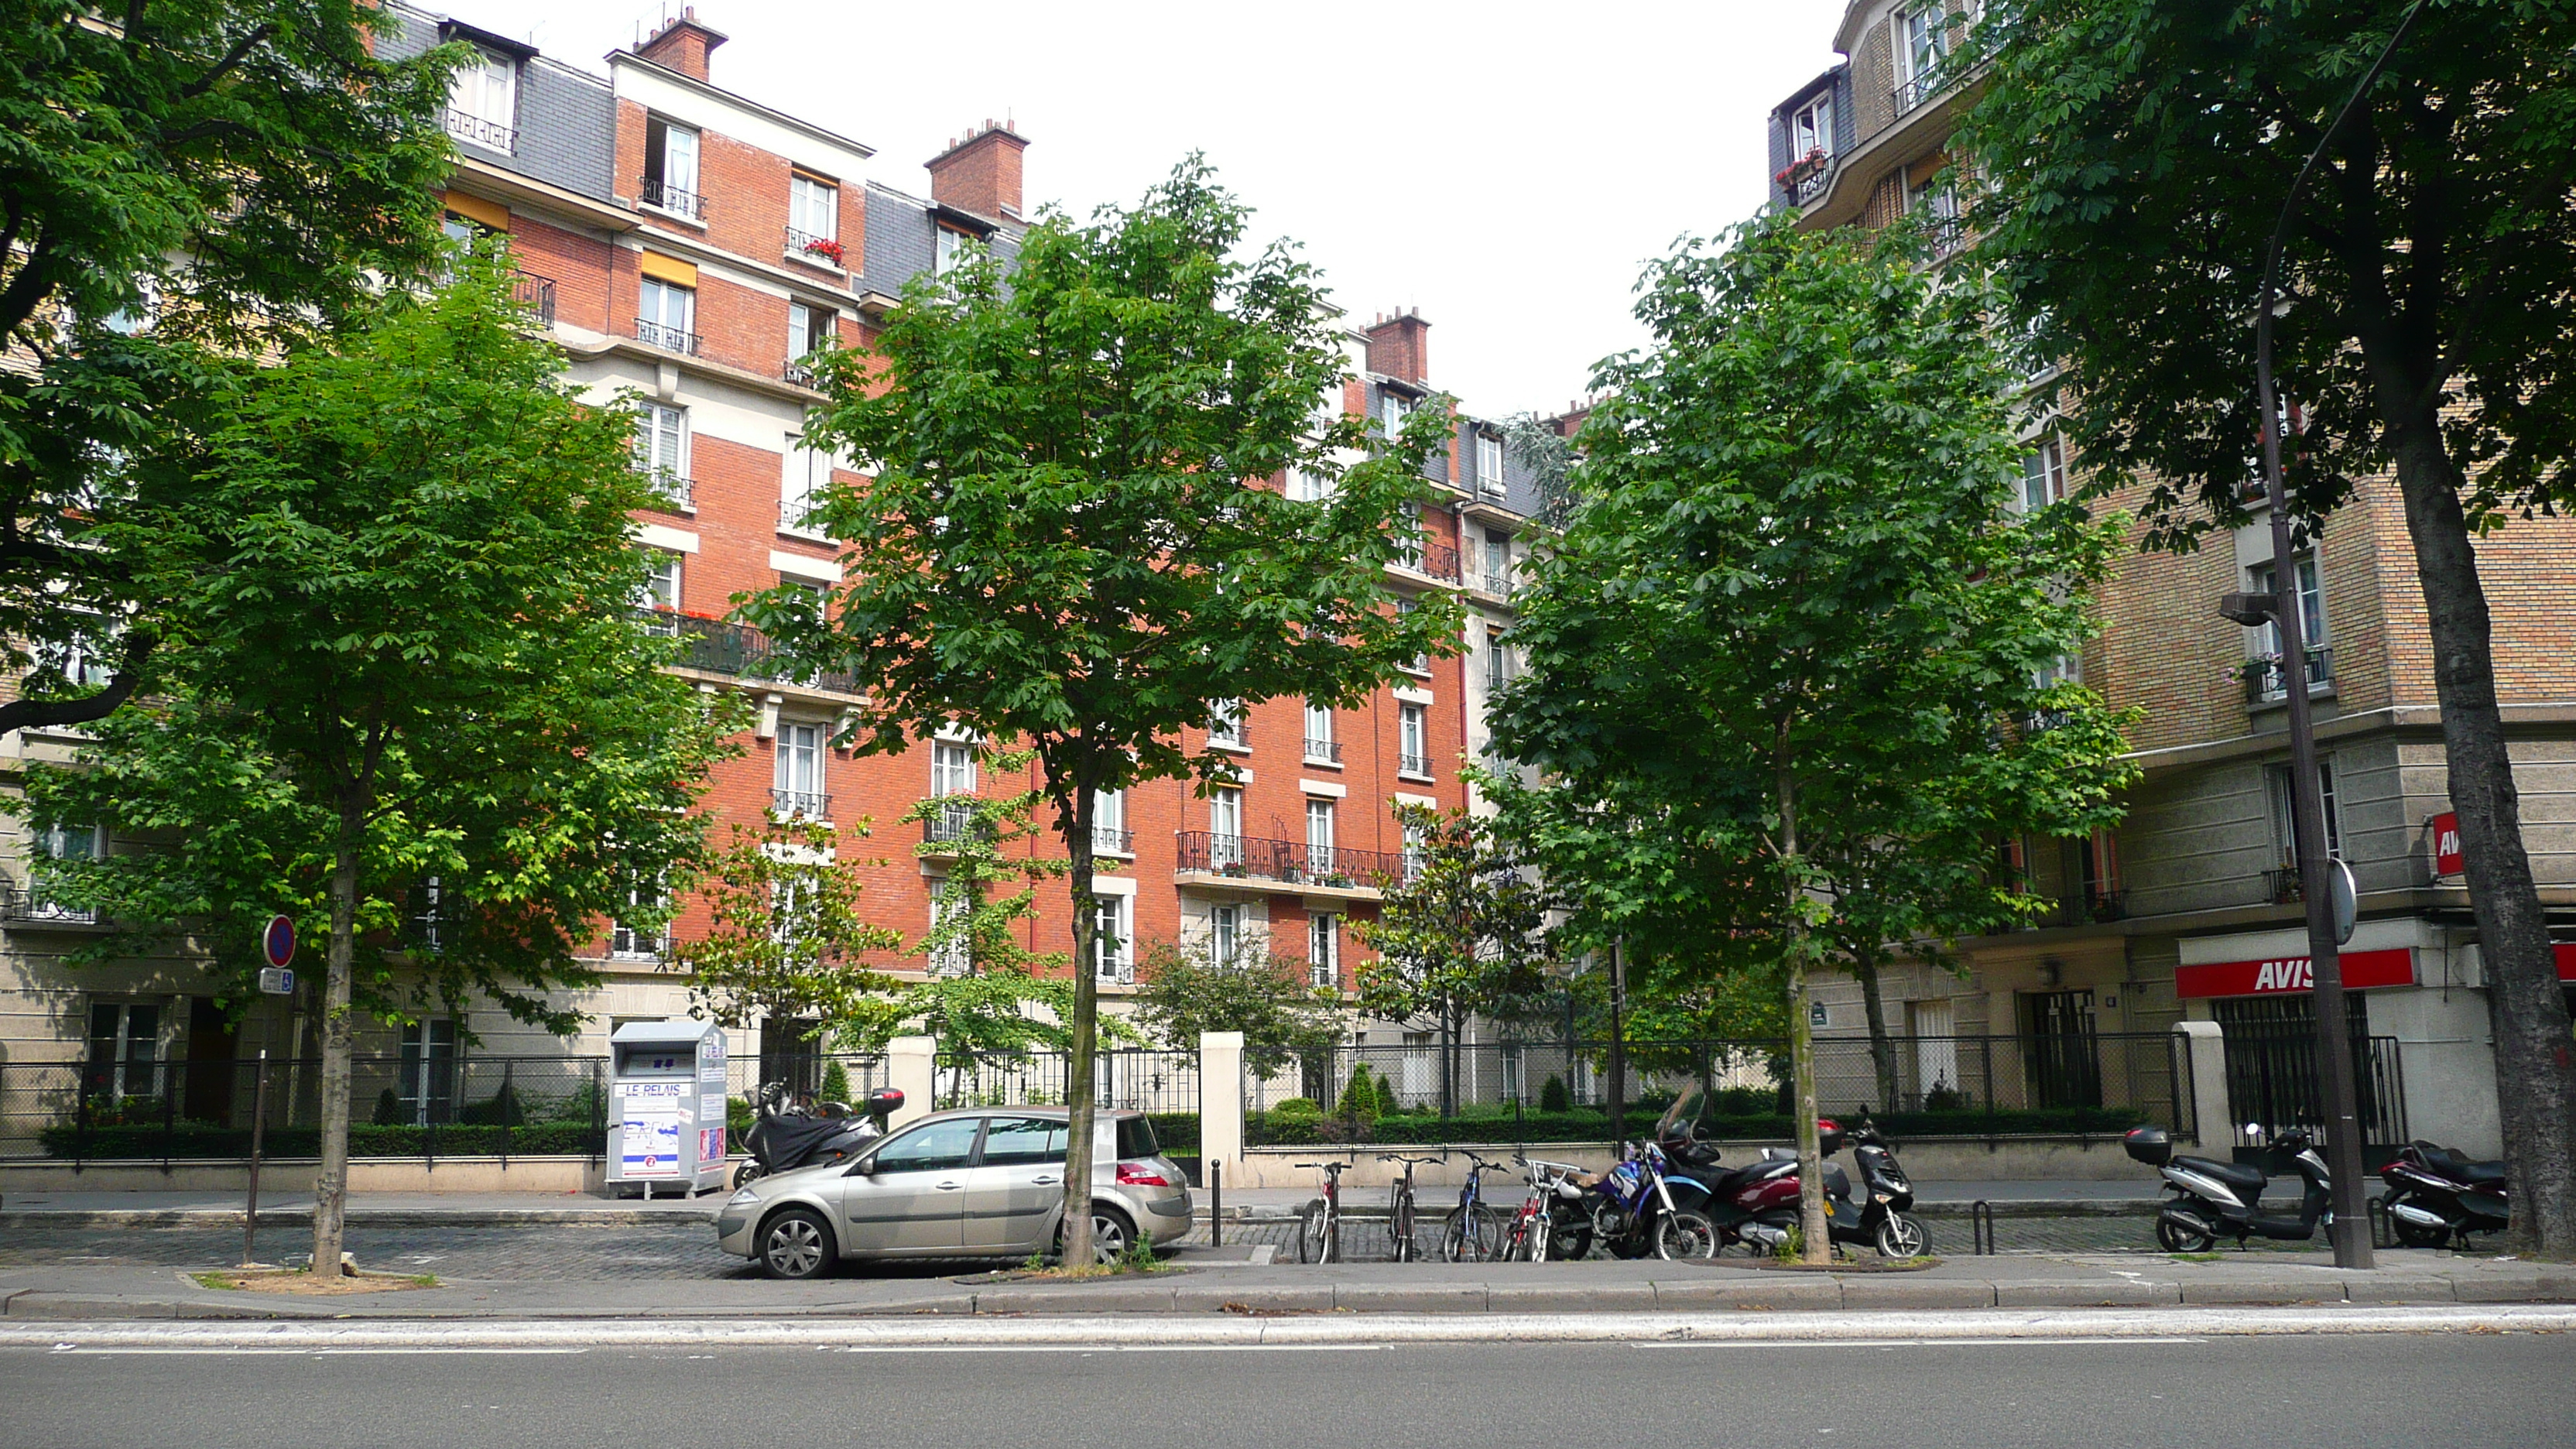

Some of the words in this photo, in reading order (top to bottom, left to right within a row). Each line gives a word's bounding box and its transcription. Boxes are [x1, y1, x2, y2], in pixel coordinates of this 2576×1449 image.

[2439, 831, 2460, 857] AV
[626, 1084, 639, 1096] LE
[643, 1084, 680, 1096] RELAIS
